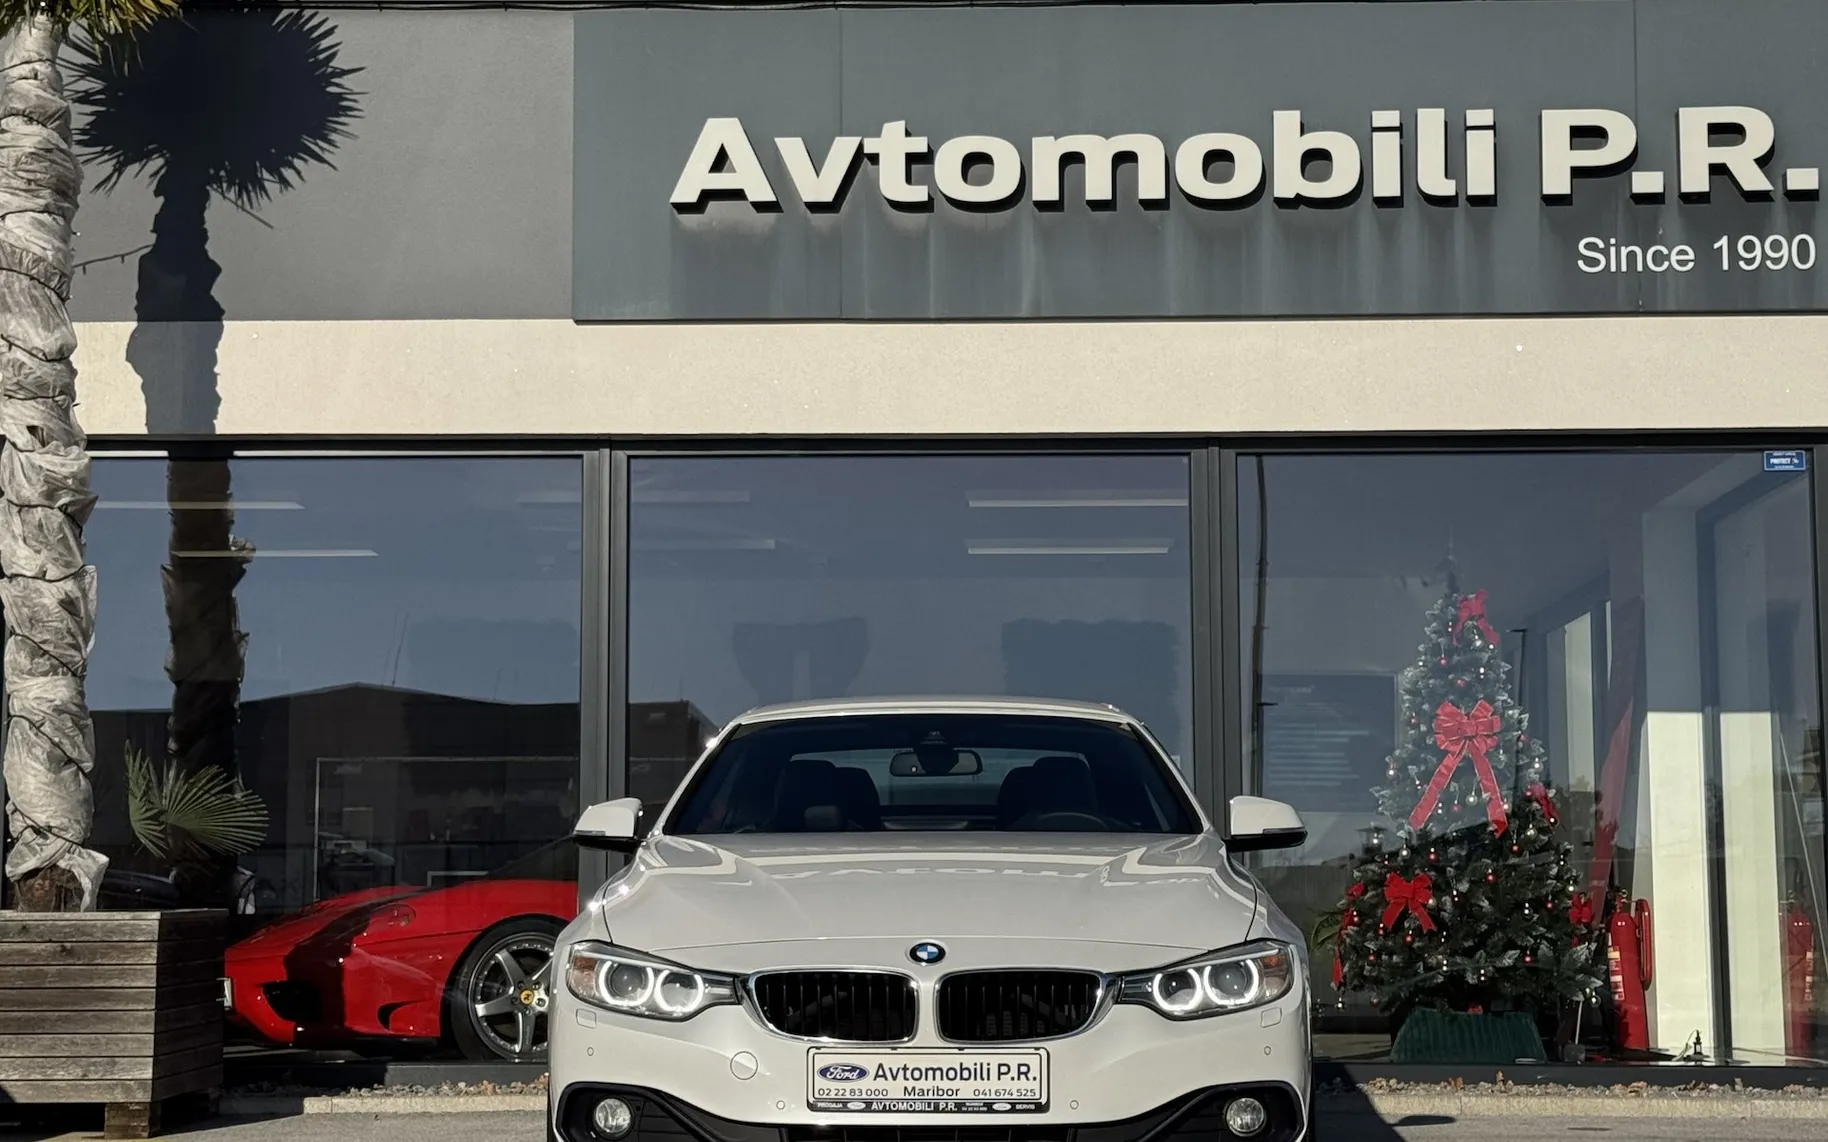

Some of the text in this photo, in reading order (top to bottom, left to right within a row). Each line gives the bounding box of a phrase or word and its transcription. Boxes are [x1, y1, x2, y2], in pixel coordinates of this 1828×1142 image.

[670, 105, 1820, 209] Avtomobili P.R.
[1577, 233, 1817, 274] Since 1990
[824, 1062, 1038, 1082] Ford Avtomobili P.R.
[817, 1085, 1037, 1097] 02 22 83 000 Maribor 041 674 525
[871, 1101, 934, 1112] AVTOMOBILI
[938, 1101, 958, 1112] P.R.
